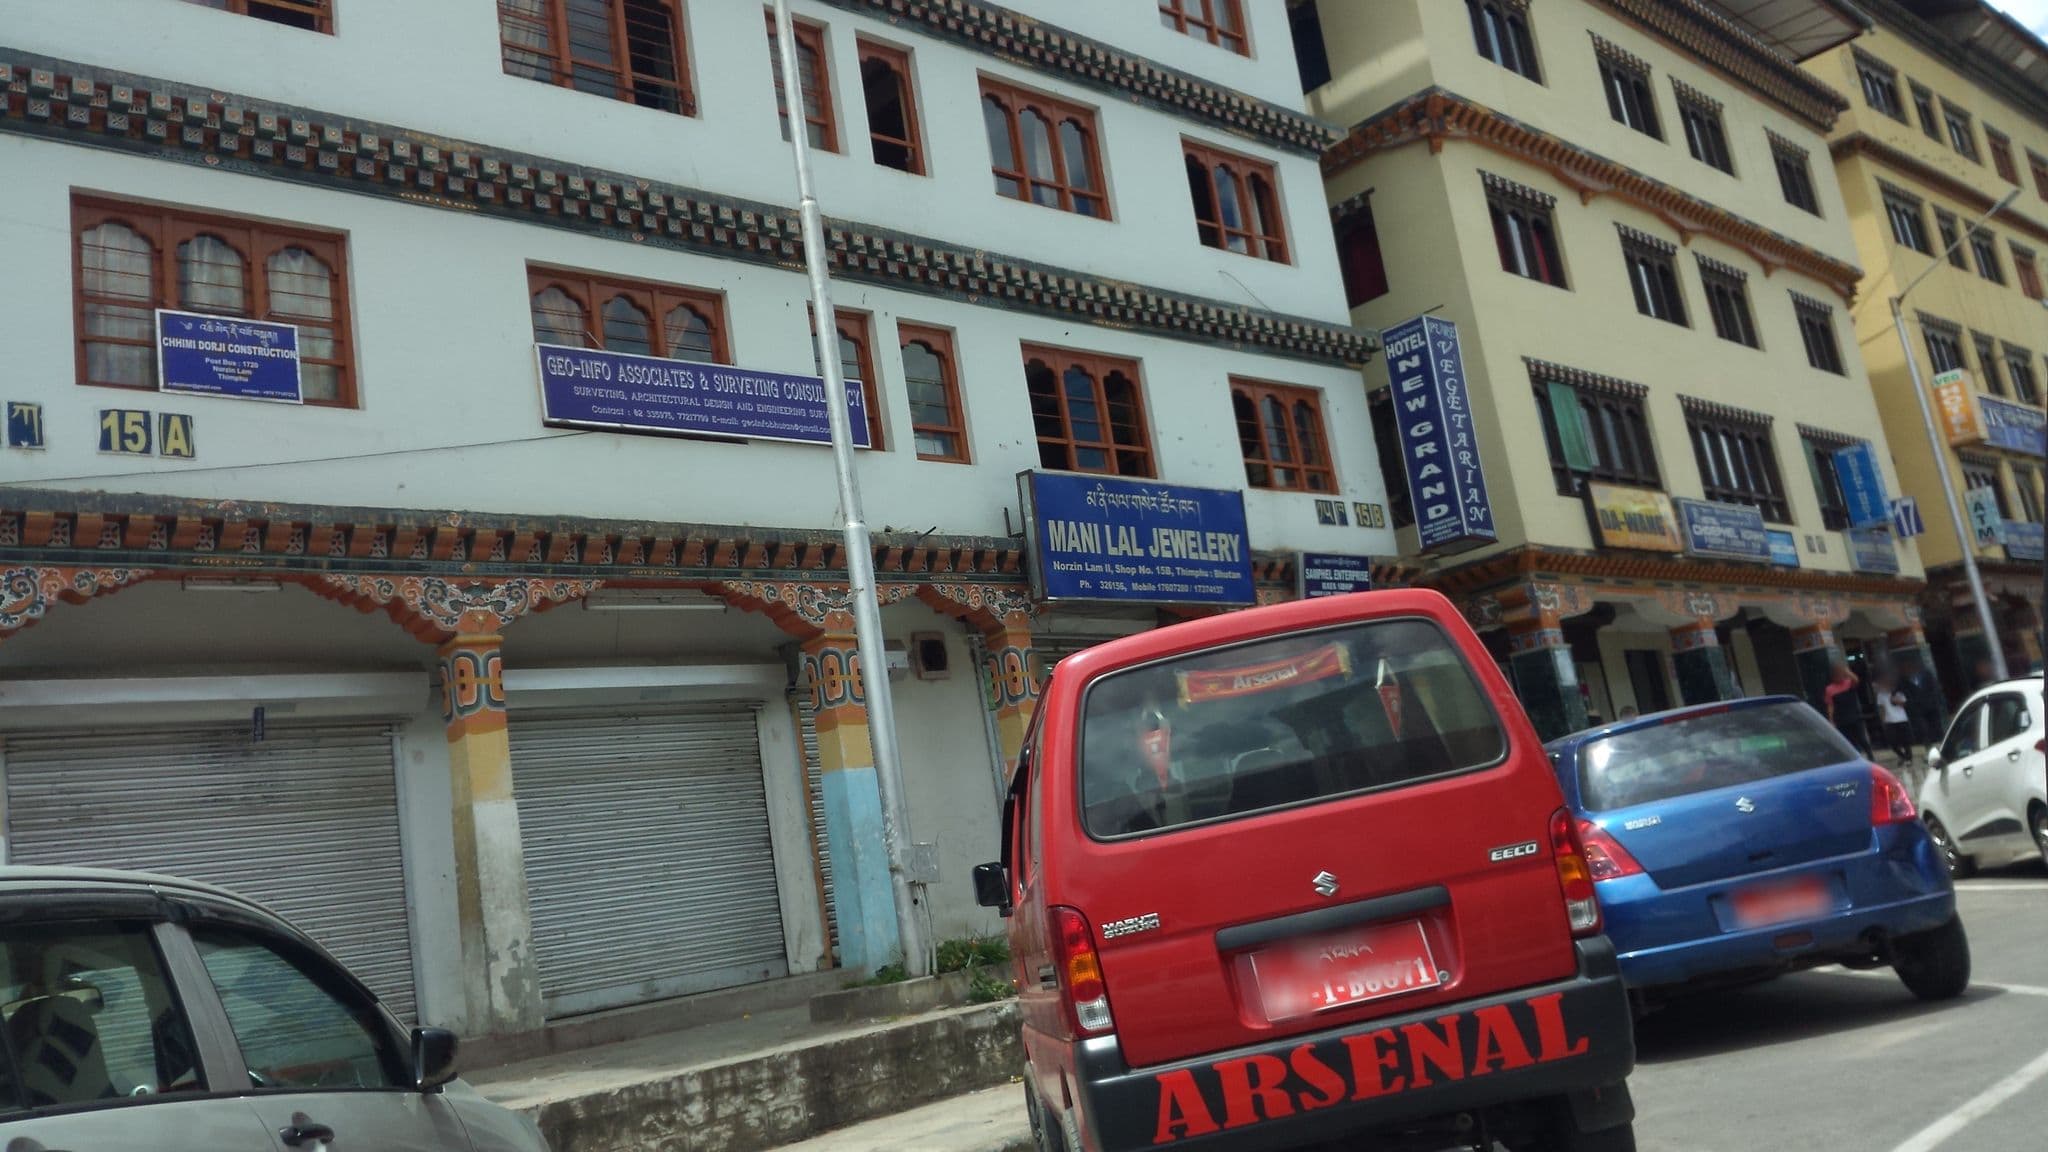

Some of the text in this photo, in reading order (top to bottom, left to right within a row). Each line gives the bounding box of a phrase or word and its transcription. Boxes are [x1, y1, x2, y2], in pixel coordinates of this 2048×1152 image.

[163, 337, 297, 360] CHHIMI DORJI CONSTRUCTION
[1385, 332, 1426, 360] HOTEL
[547, 356, 861, 407] GEO-INFO ASSOCIATES & SURVEYING CONSULCY
[1399, 355, 1427, 412] NEW
[592, 405, 624, 416] Contact
[631, 392, 701, 407] ARCHITECTURAL
[704, 398, 733, 410] DESIGN
[736, 401, 754, 412] AND
[757, 403, 807, 417] ENGINEERING
[102, 411, 147, 452] 15
[1410, 421, 1450, 520] GRAND
[1973, 501, 1995, 541] ATM
[1048, 519, 1240, 562] MANI LAL JEWELERY
[1053, 561, 1083, 571] Norzin
[1084, 562, 1103, 572] Lam
[1115, 564, 1137, 576] Shop
[1138, 565, 1153, 575] No.
[1175, 567, 1209, 578] Thimphu
[1080, 580, 1092, 589] Ph.
[1132, 582, 1156, 592] Mobile
[1233, 665, 1298, 688] Arsenal
[1491, 843, 1537, 861] EECO
[1102, 912, 1158, 929] MARUTI
[1104, 919, 1160, 939] SUZUKI
[1153, 992, 1589, 1145] ARSENAL
